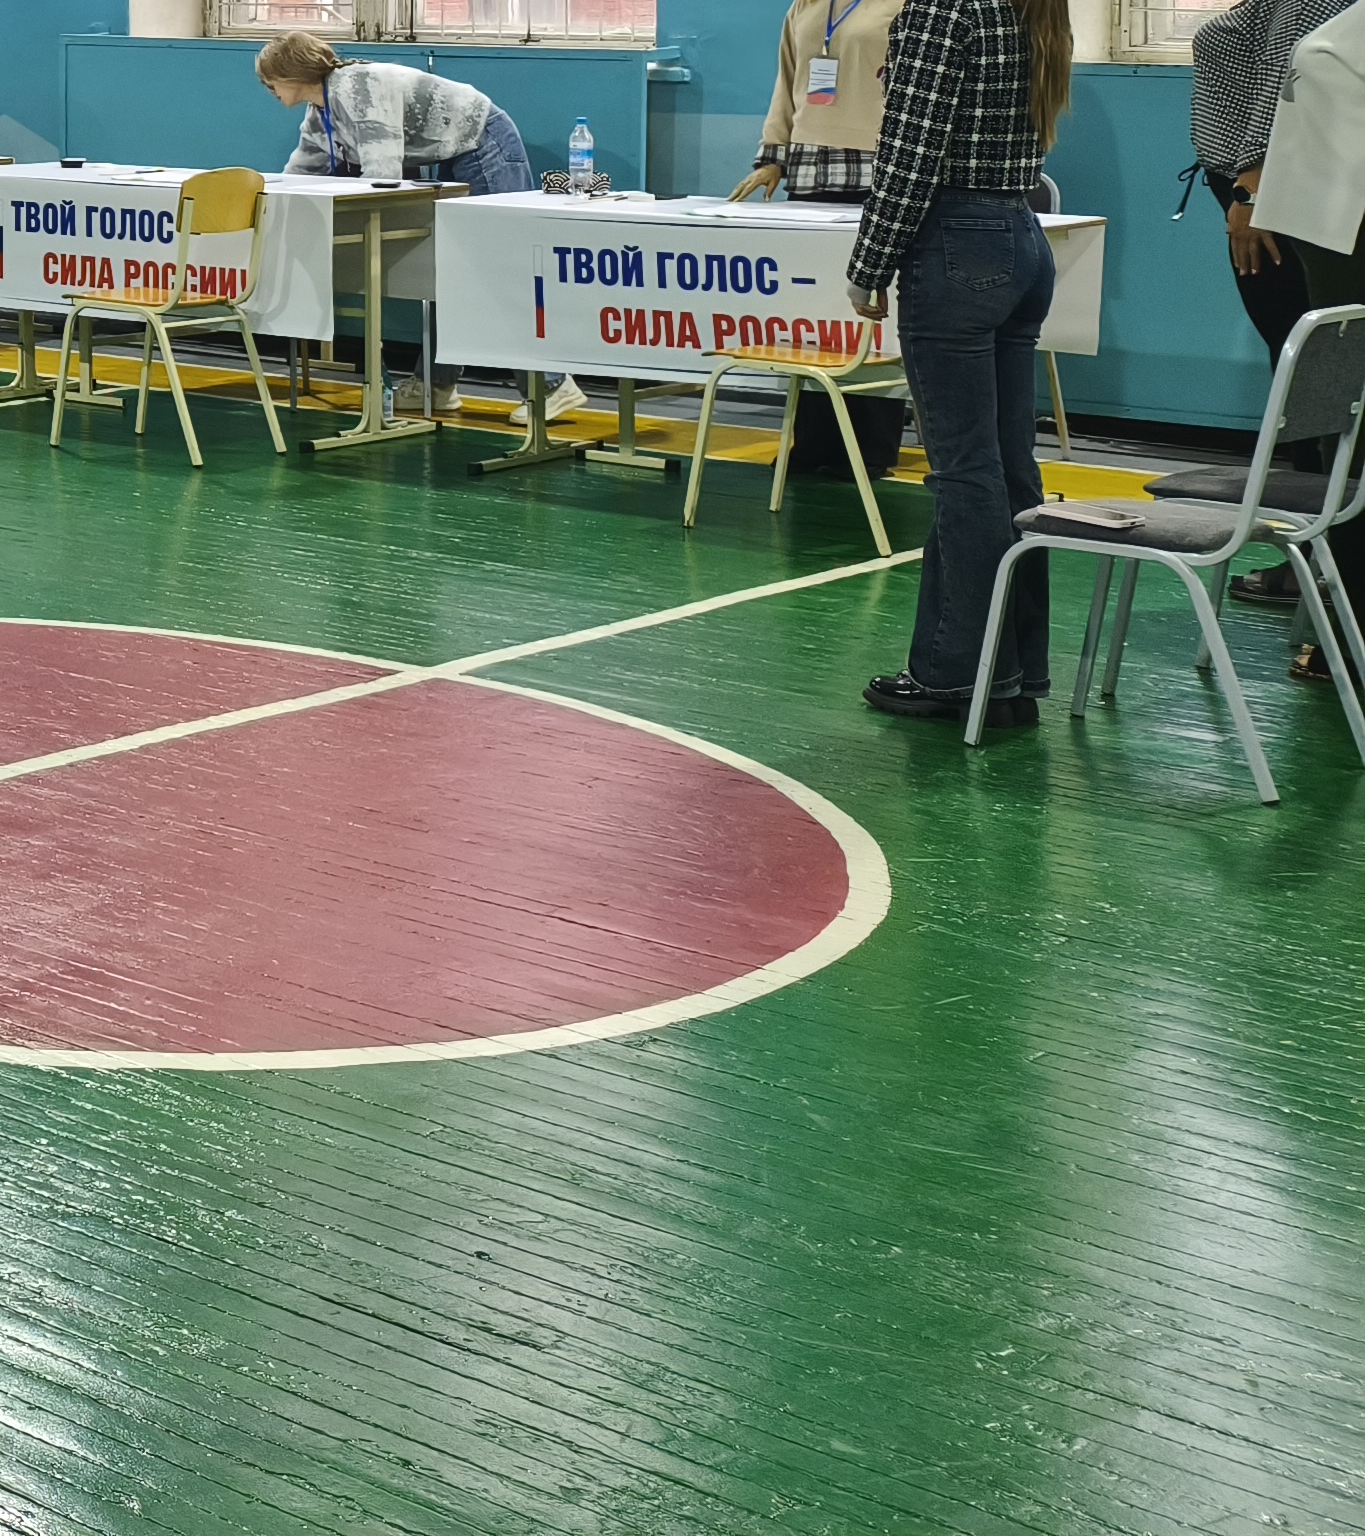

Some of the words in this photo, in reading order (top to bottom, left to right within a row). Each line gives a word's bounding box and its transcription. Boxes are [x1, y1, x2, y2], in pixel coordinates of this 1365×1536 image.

[10, 199, 77, 237] ТВОЙ
[85, 205, 175, 244] ГОЛОС
[43, 251, 115, 290] СИЛА
[552, 244, 645, 288] ТВОЙ
[656, 251, 779, 296] ГОЛОС
[599, 306, 702, 350] СИЛА
